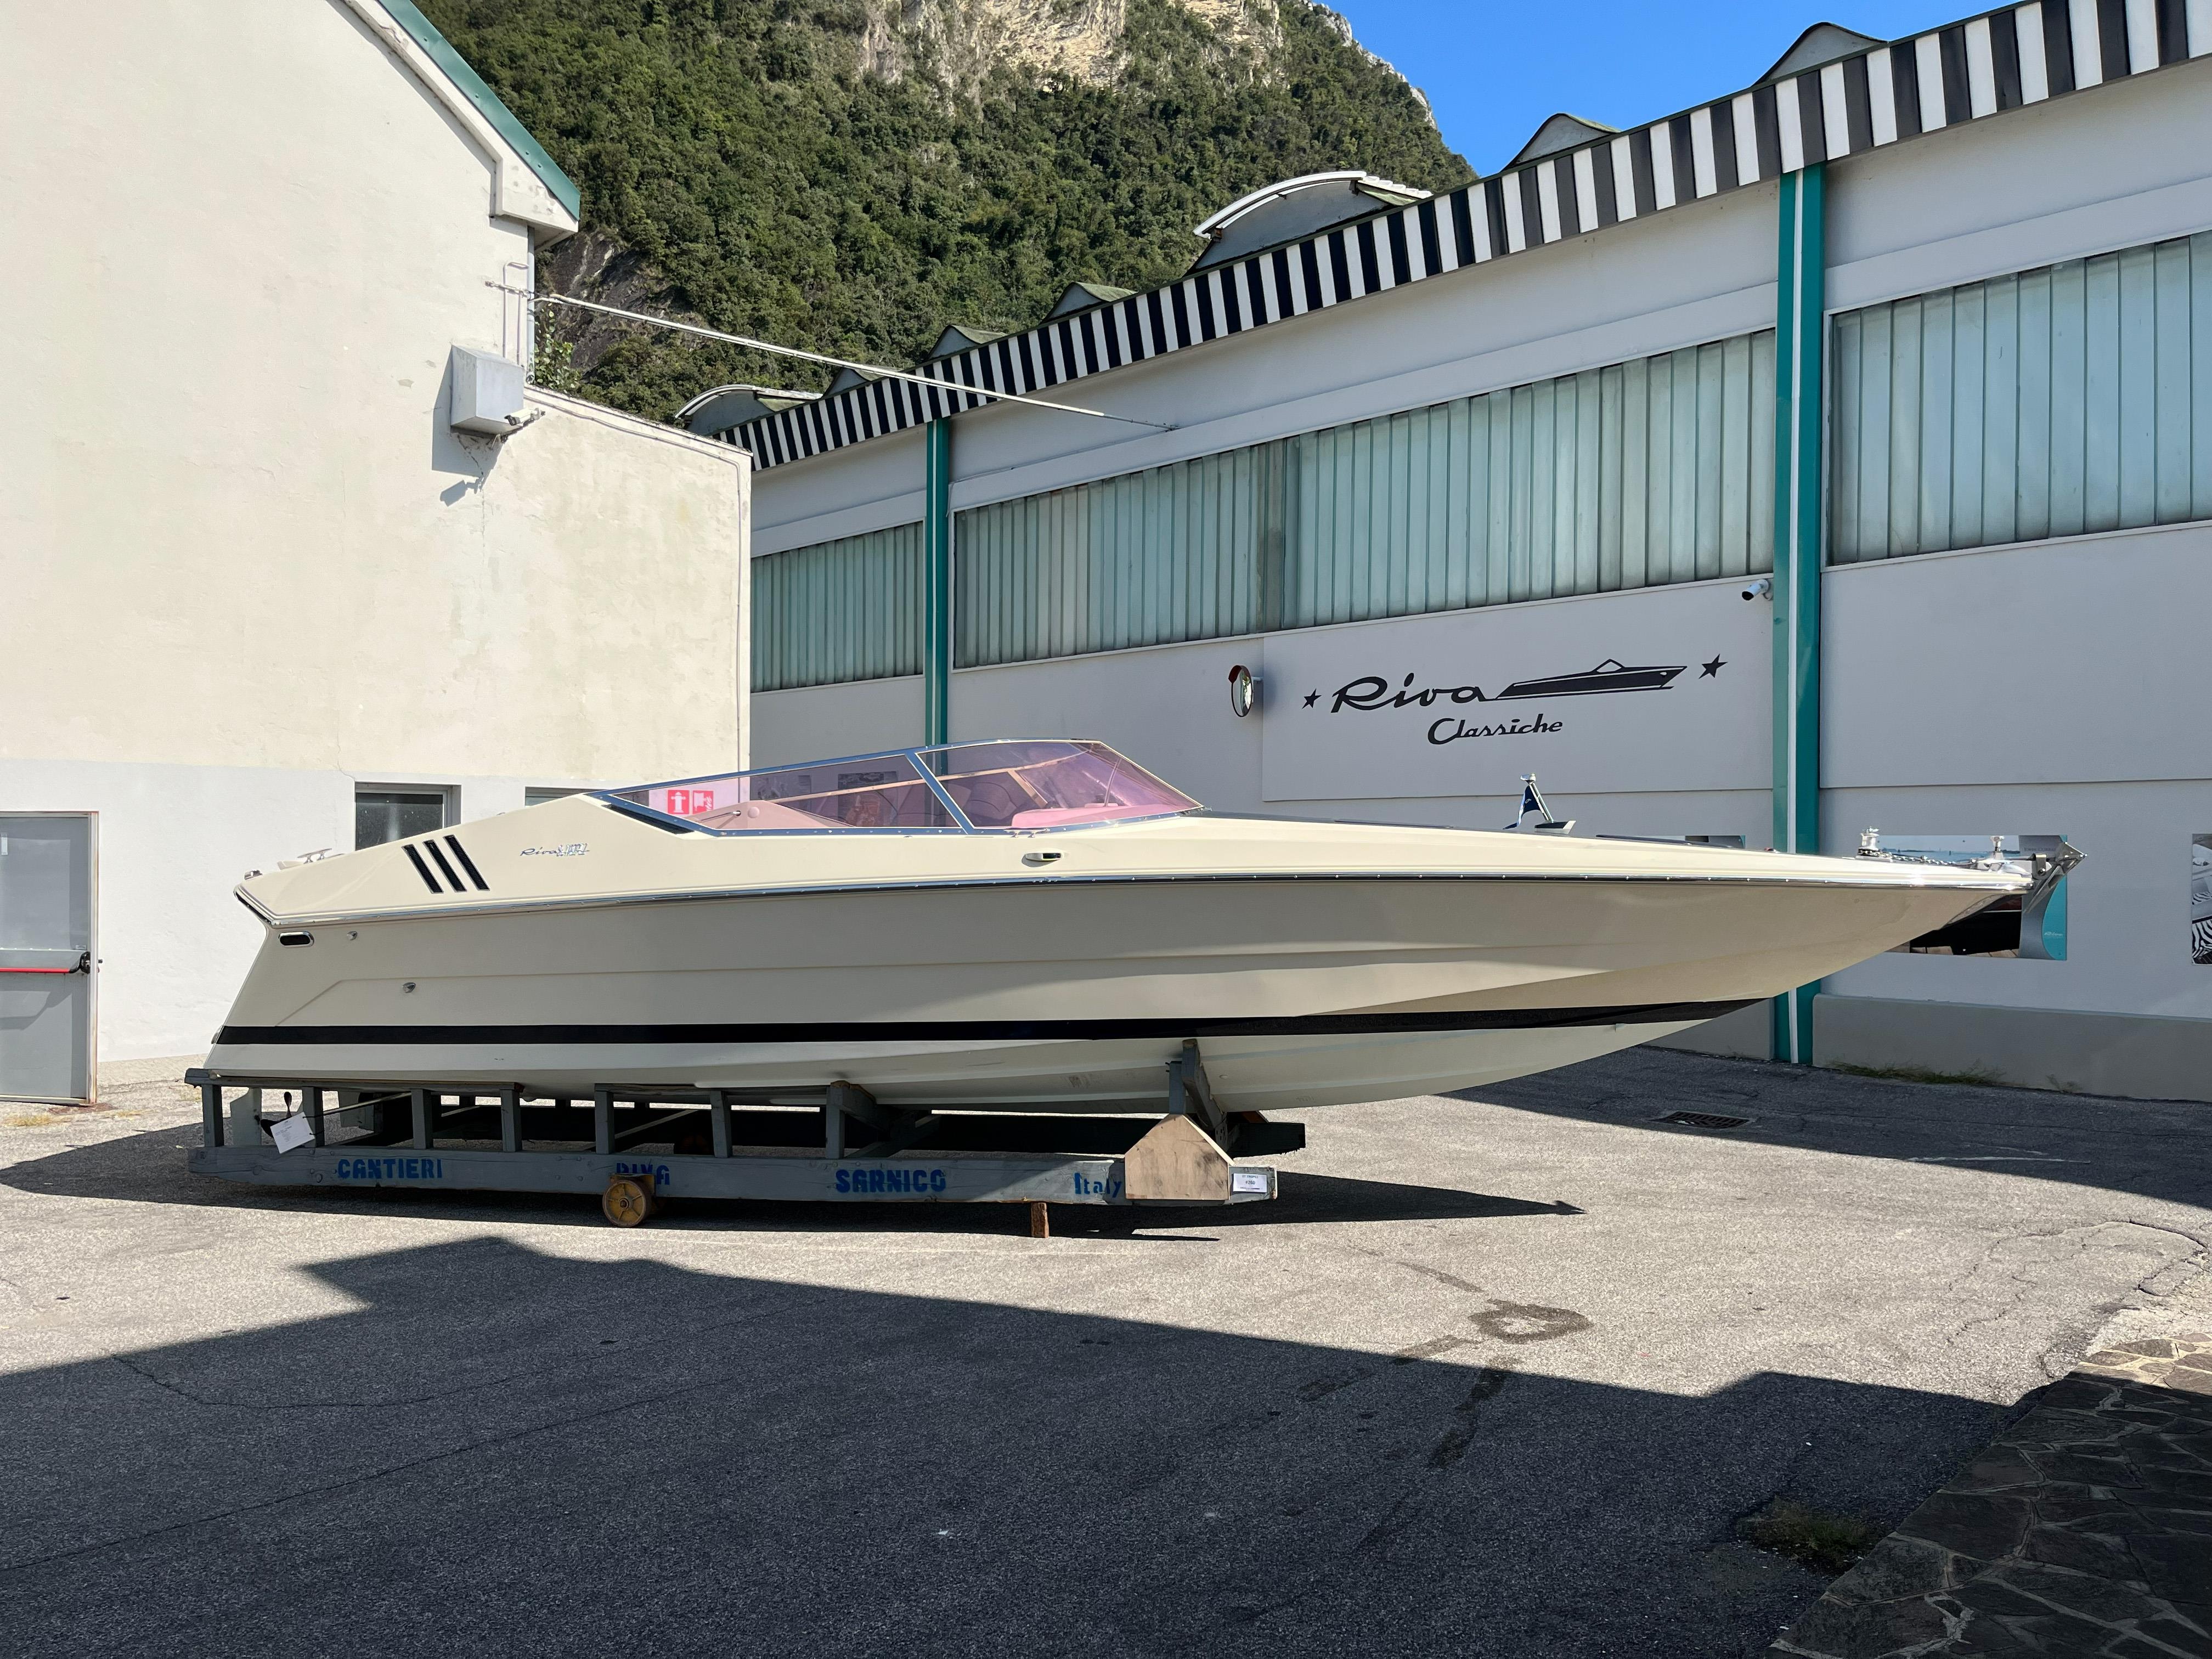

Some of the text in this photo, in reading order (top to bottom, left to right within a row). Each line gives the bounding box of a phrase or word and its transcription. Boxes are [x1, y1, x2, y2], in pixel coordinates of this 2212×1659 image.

[1330, 673, 1486, 713] Riva
[1427, 714, 1563, 744] Classiche
[520, 847, 557, 856] Riva
[337, 1159, 442, 1179] CANTIERI
[836, 1169, 946, 1193] SARNICO
[1074, 1172, 1122, 1198] Italy
